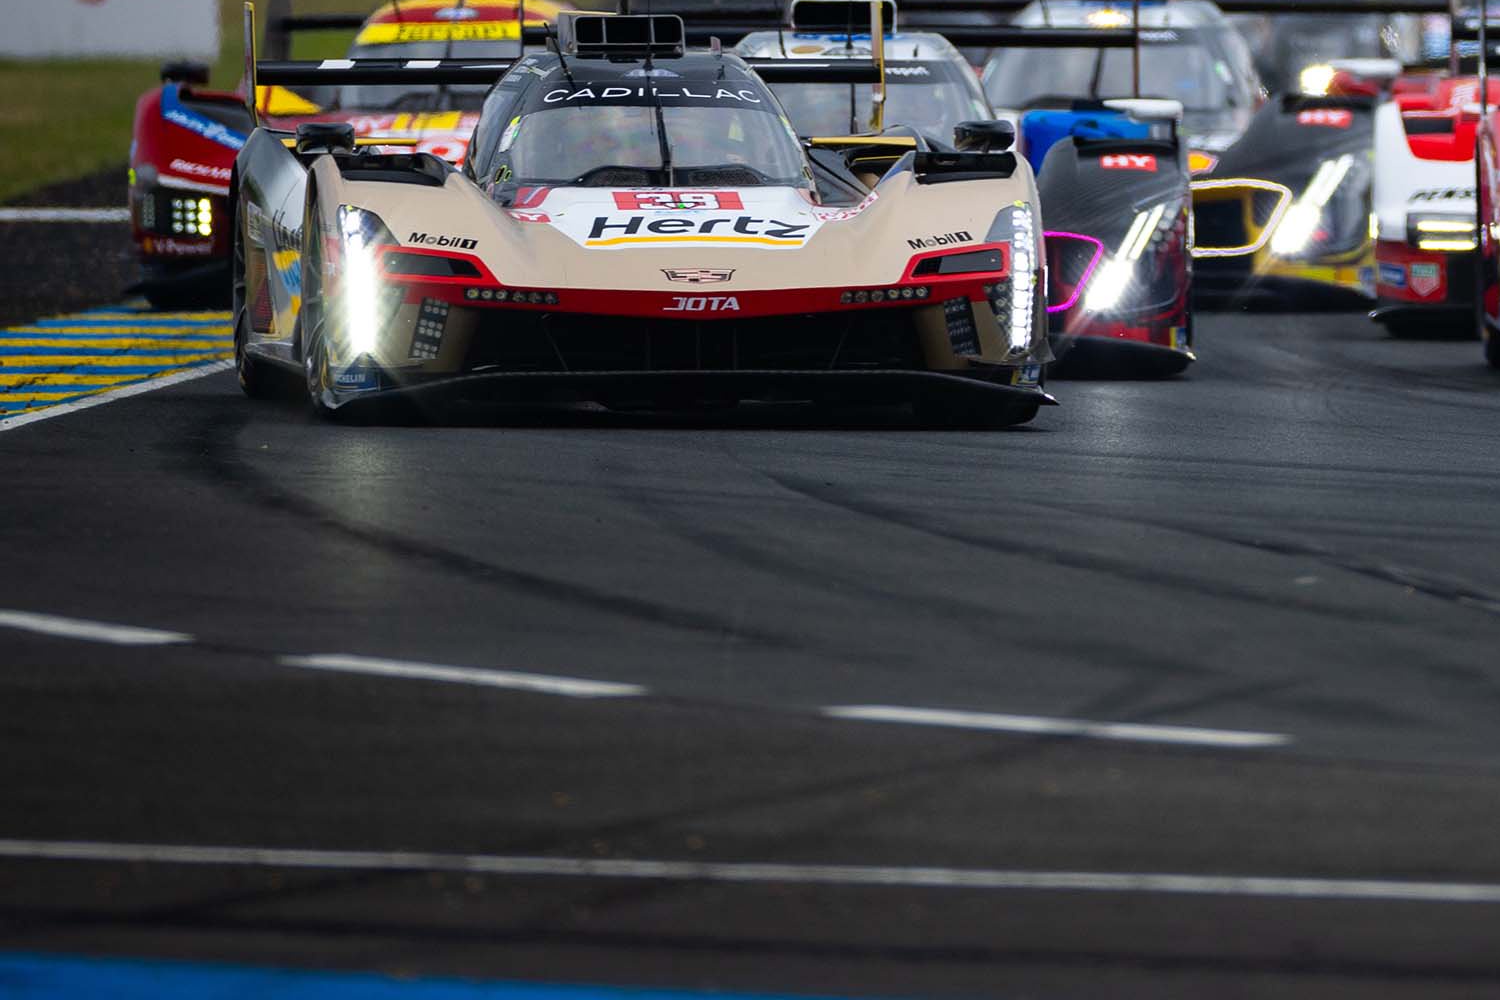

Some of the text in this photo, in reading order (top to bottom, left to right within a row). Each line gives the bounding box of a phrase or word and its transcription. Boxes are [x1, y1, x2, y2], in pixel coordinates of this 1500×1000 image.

[543, 87, 761, 103] CADILLAC
[1102, 154, 1150, 168] HY
[588, 216, 811, 238] Hertz
[662, 296, 741, 311] JOTA
